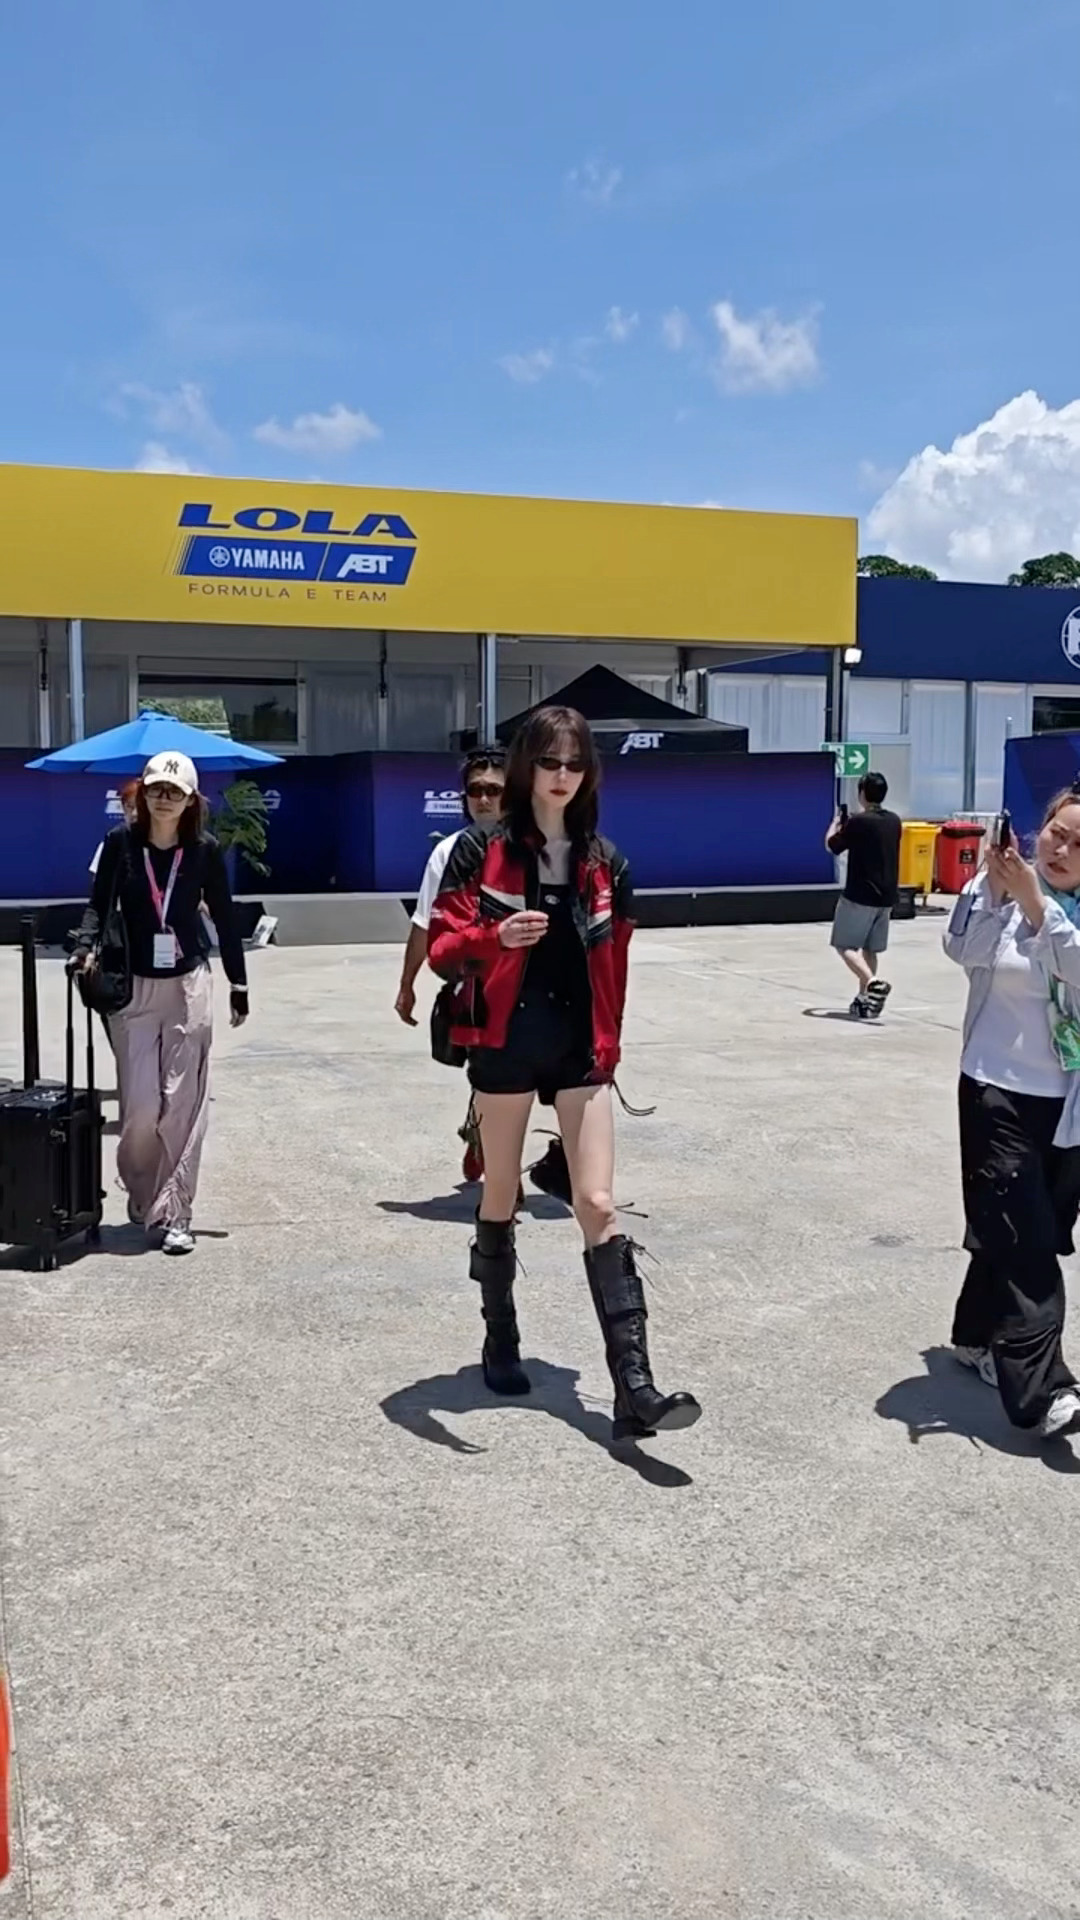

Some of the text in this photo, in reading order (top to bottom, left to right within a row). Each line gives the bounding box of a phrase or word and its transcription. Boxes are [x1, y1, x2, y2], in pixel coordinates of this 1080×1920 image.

[178, 503, 418, 539] LOLA
[231, 547, 393, 578] YAMAHA ABT
[188, 583, 387, 602] FORMULA E TEAM
[620, 732, 664, 755] ABT
[424, 790, 466, 799] LO
